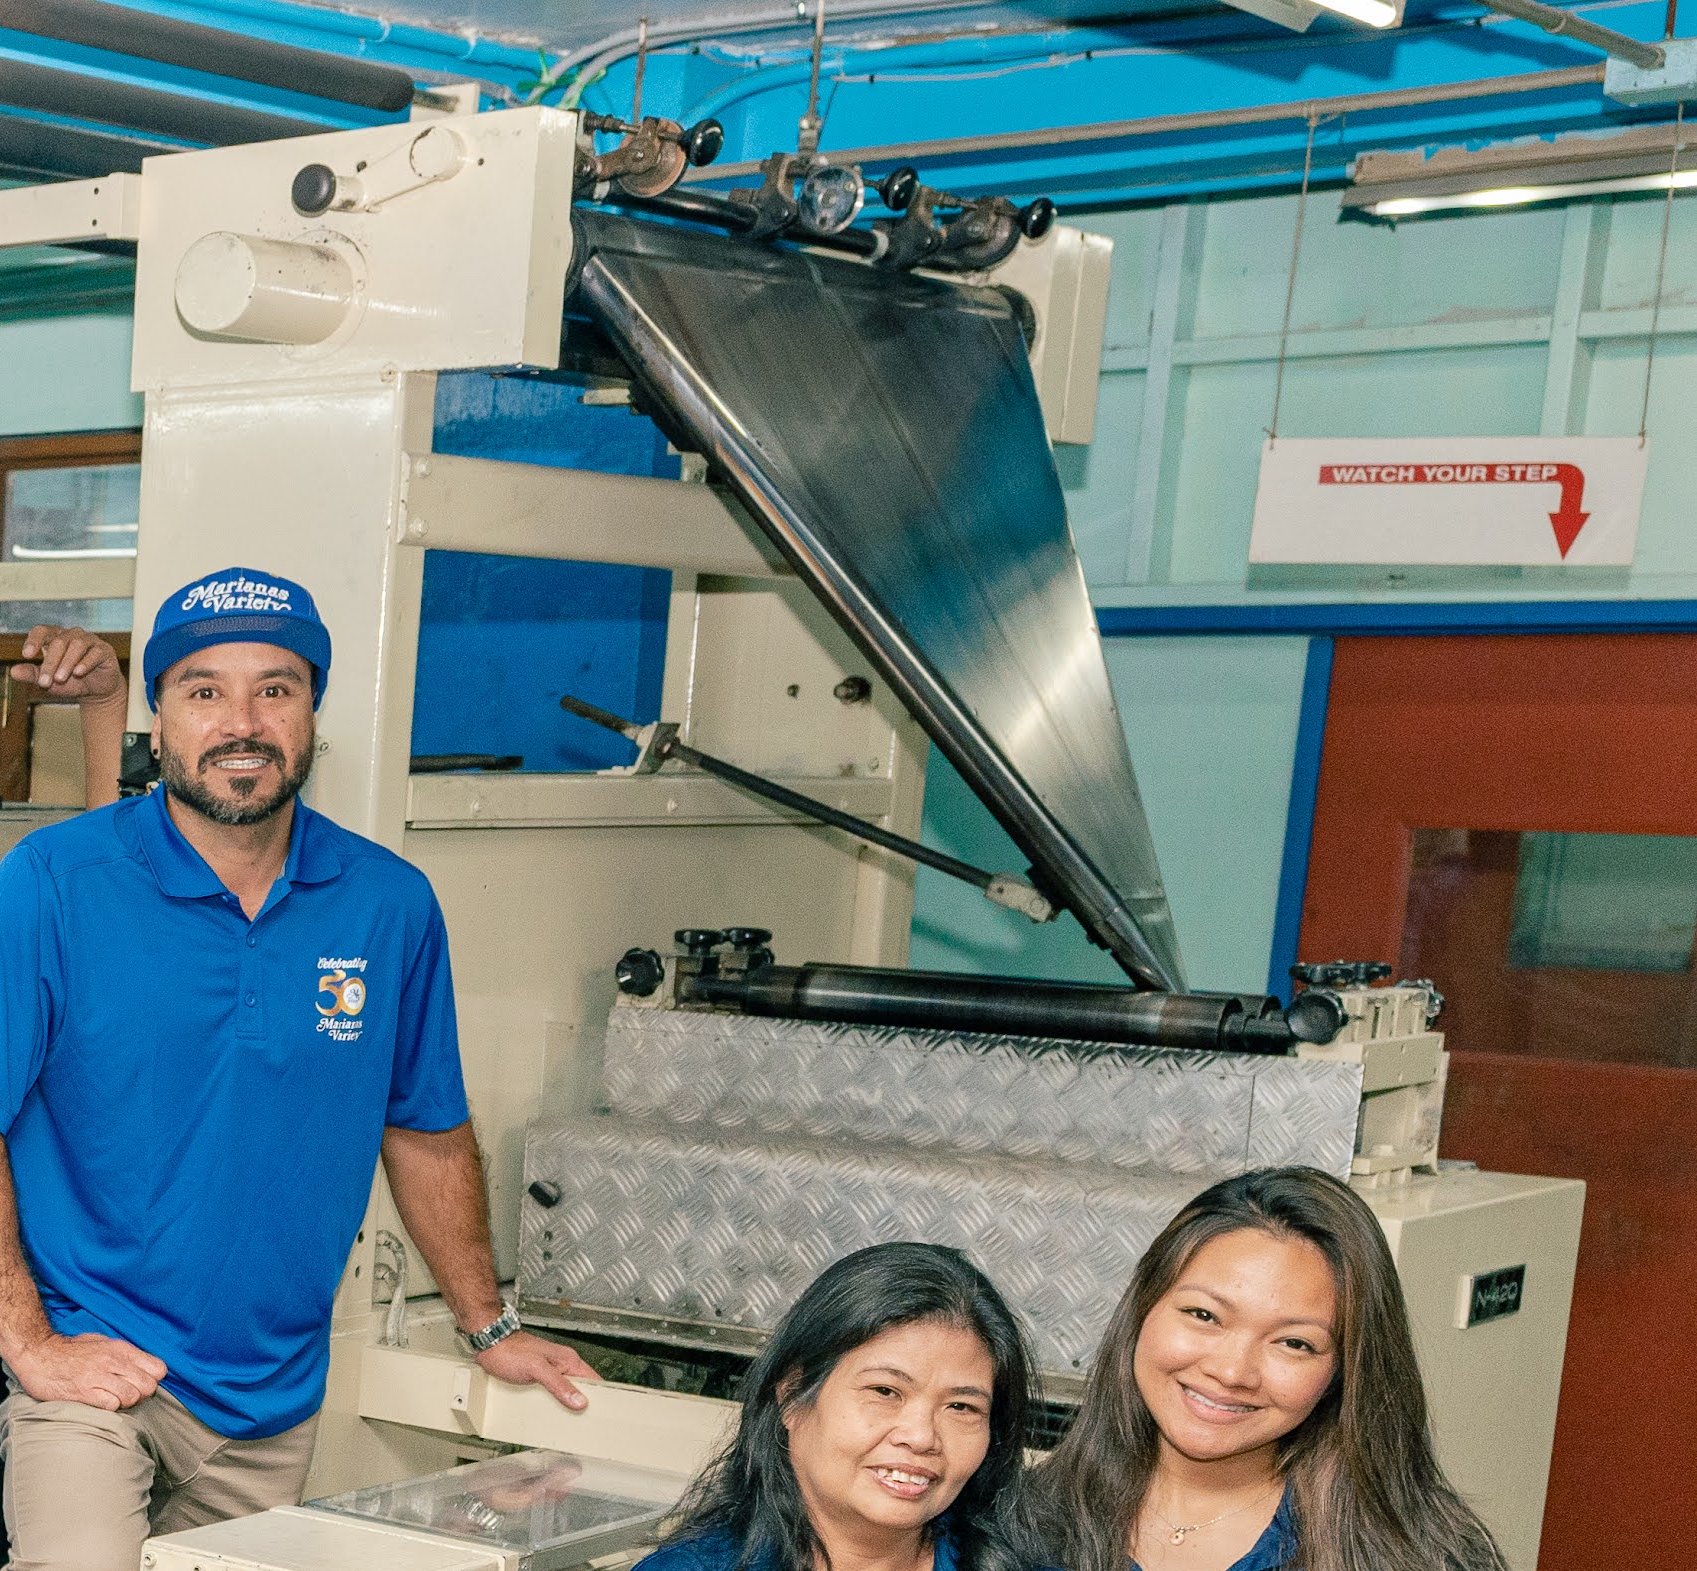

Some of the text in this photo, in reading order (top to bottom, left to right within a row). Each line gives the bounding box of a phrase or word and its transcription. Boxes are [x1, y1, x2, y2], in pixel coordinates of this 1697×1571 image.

[1333, 465, 1558, 482] WATCH YOUR STEP
[182, 577, 289, 611] Marianas
[202, 593, 292, 613] Variety
[315, 969, 366, 1016] 50
